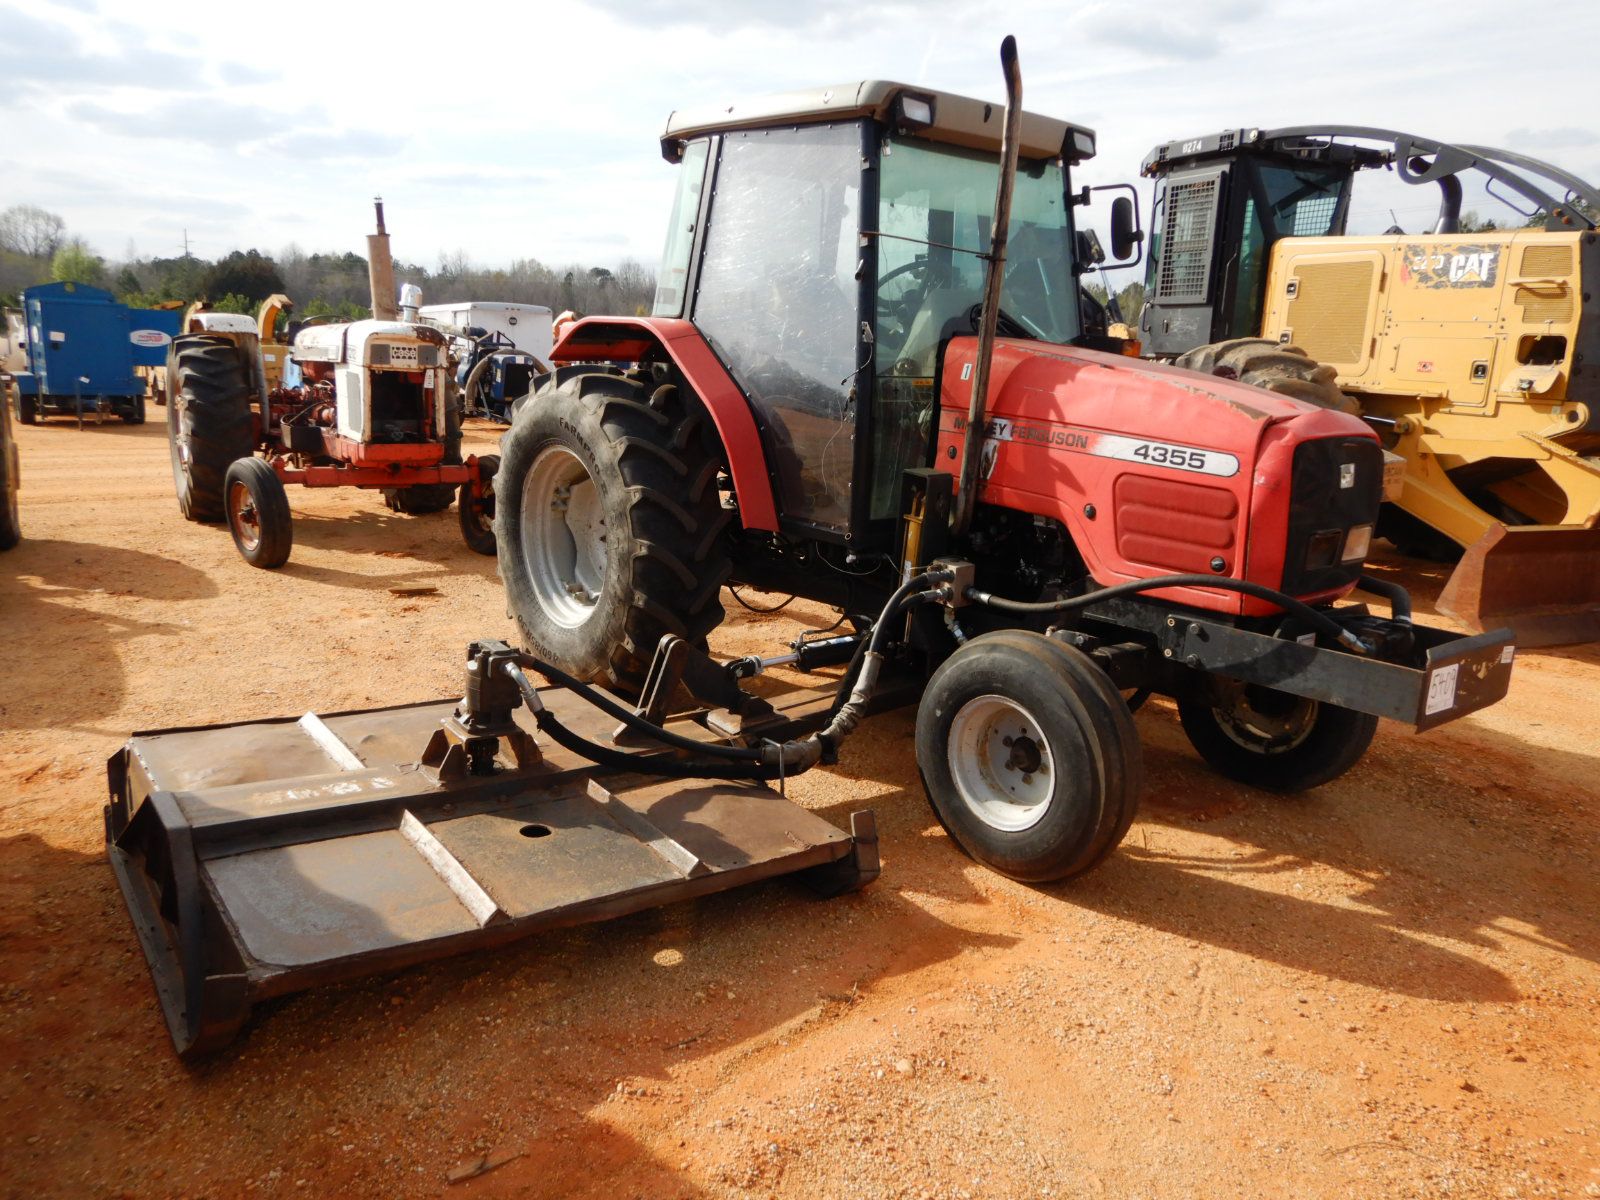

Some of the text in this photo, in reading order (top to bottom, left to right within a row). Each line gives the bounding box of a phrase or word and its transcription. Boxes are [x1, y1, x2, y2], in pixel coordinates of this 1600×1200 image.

[1449, 252, 1495, 282] CAT
[1011, 424, 1088, 448] FERGUSON
[1133, 444, 1207, 469] 4355
